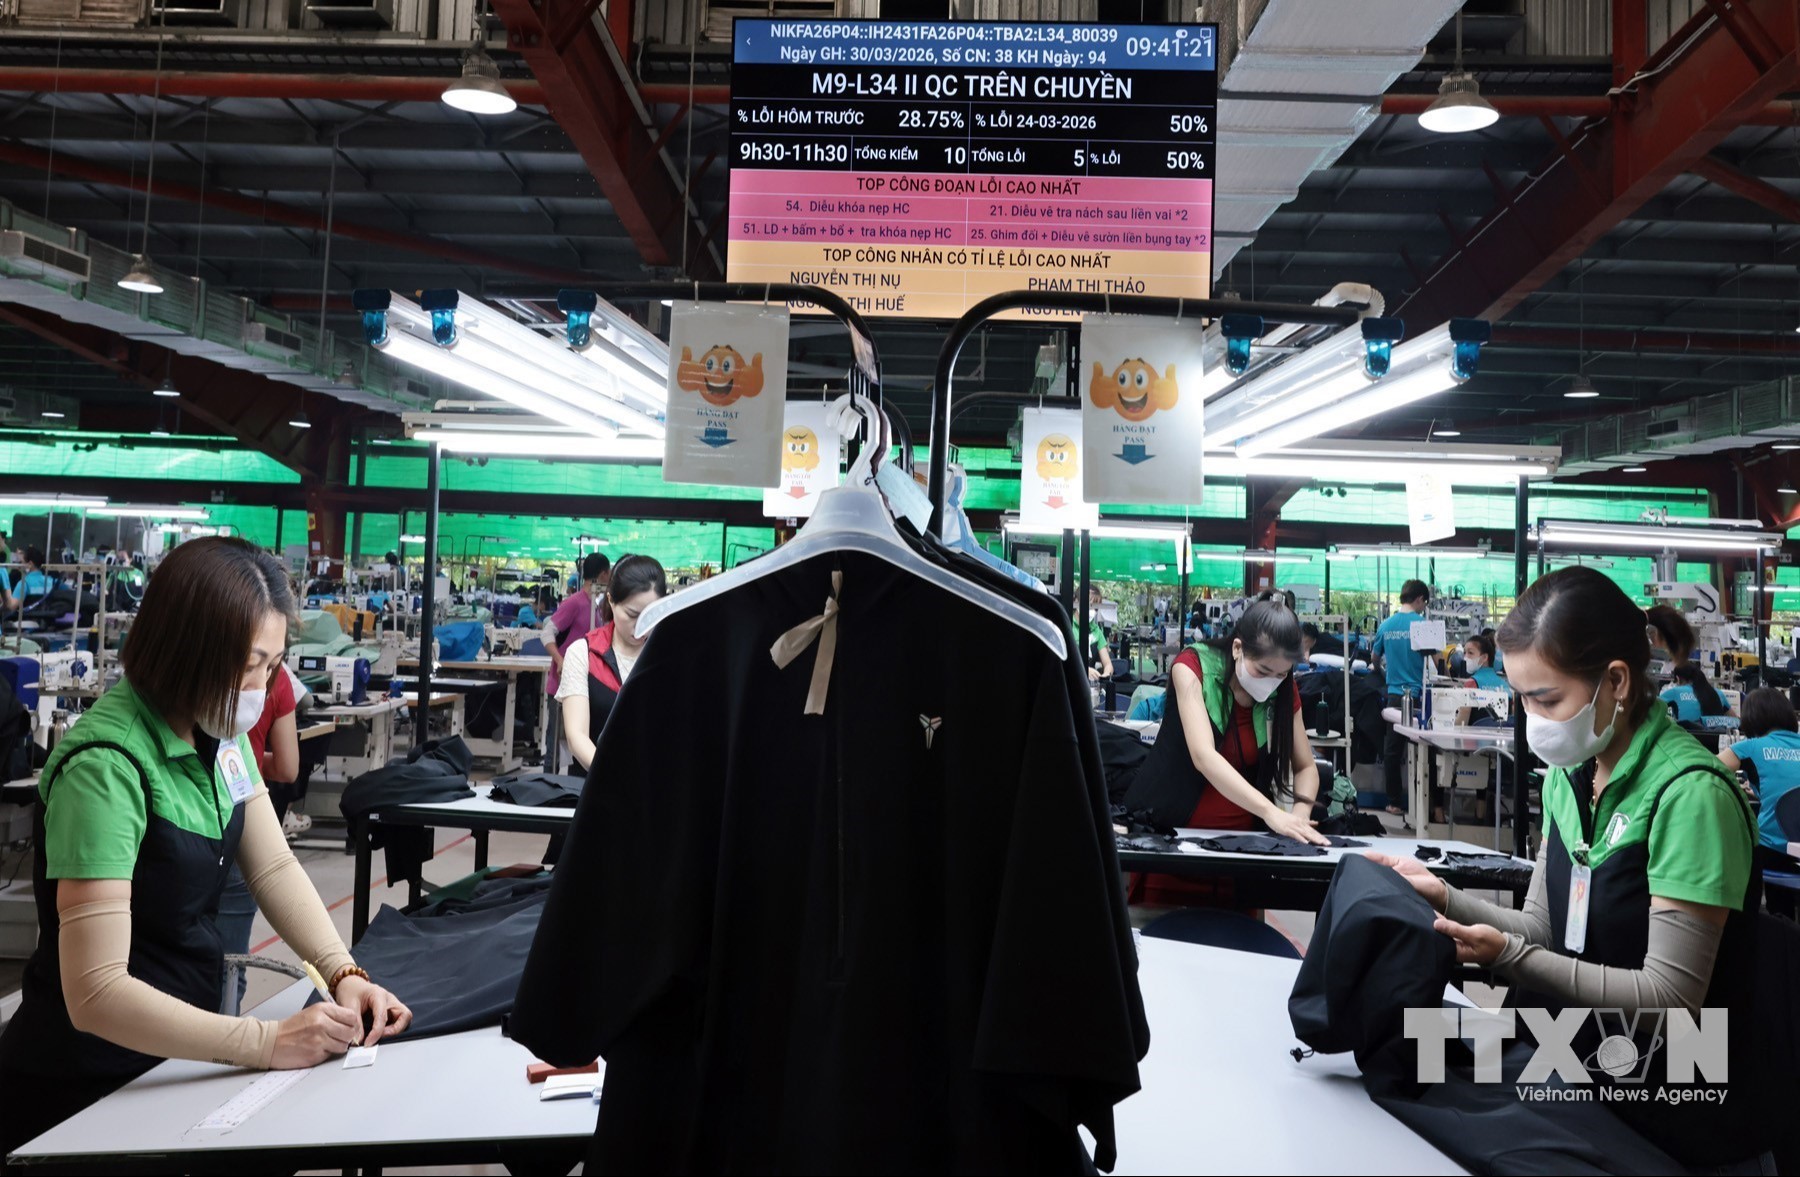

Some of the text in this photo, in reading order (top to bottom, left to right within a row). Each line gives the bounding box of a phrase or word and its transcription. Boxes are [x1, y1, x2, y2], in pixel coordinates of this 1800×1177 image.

[770, 23, 1118, 44] NIKFA26P04::IH2431FA26P04::TBA2:L34_80039
[780, 45, 1106, 67] Ngày GH: 30/03/2026, Số CN: 38 KH Ngày: 94
[1126, 37, 1212, 58] 09:41:21
[812, 72, 897, 95] M9-L34
[925, 74, 958, 98] QC
[964, 70, 1026, 97] TRÊN
[1034, 70, 1132, 99] CHUYỀN
[737, 106, 864, 125] % LỖI HÔM TRƯỚC
[899, 109, 965, 128] 28.75%
[975, 110, 1096, 129] % LỖI 24-03-2026
[1170, 115, 1208, 133] 50%
[740, 142, 848, 162] 9h30-11h30
[854, 145, 918, 161] TỔNG KIỂM
[944, 147, 966, 165] 10
[972, 148, 1026, 163] TỔNG LỖI
[1074, 149, 1085, 167] 5
[1090, 149, 1121, 165] % LỖI
[1166, 151, 1205, 170] 50%
[857, 175, 1081, 196] TOP CÔNG ĐOẠN LỖI CAO NHẤT
[785, 200, 803, 212] 54.
[838, 200, 865, 214] khóa
[869, 202, 889, 216] nẹp
[893, 203, 910, 214] HC
[989, 204, 1007, 216] 21.
[1056, 207, 1072, 218] tra
[1075, 205, 1103, 219] nách
[1107, 209, 1127, 220] sau
[1155, 209, 1172, 221] vai
[743, 222, 760, 235] 51.
[764, 223, 779, 235] LD
[782, 226, 789, 234] +
[792, 222, 817, 236] bấm
[820, 227, 827, 235] +
[848, 227, 854, 235] +
[861, 226, 876, 237] tra
[880, 225, 907, 238] khóa
[910, 228, 931, 241] nẹp
[935, 228, 952, 239] HC
[970, 229, 987, 241] 25.
[990, 229, 1018, 241] Ghim
[1041, 232, 1048, 240] +
[1145, 232, 1172, 247] bụng
[1175, 233, 1191, 246] tay
[823, 246, 1111, 269] TOP CÔNG NHÂN CÓ TỈ LỆ LỖI CAO NHẤT
[790, 267, 901, 289] NGUYỄN THỊ NỤ
[1105, 276, 1146, 294] THẢO
[876, 294, 906, 311] HUẾ
[707, 420, 727, 428] PASS
[1112, 423, 1138, 433] HÀNG
[1124, 436, 1145, 444] PASS
